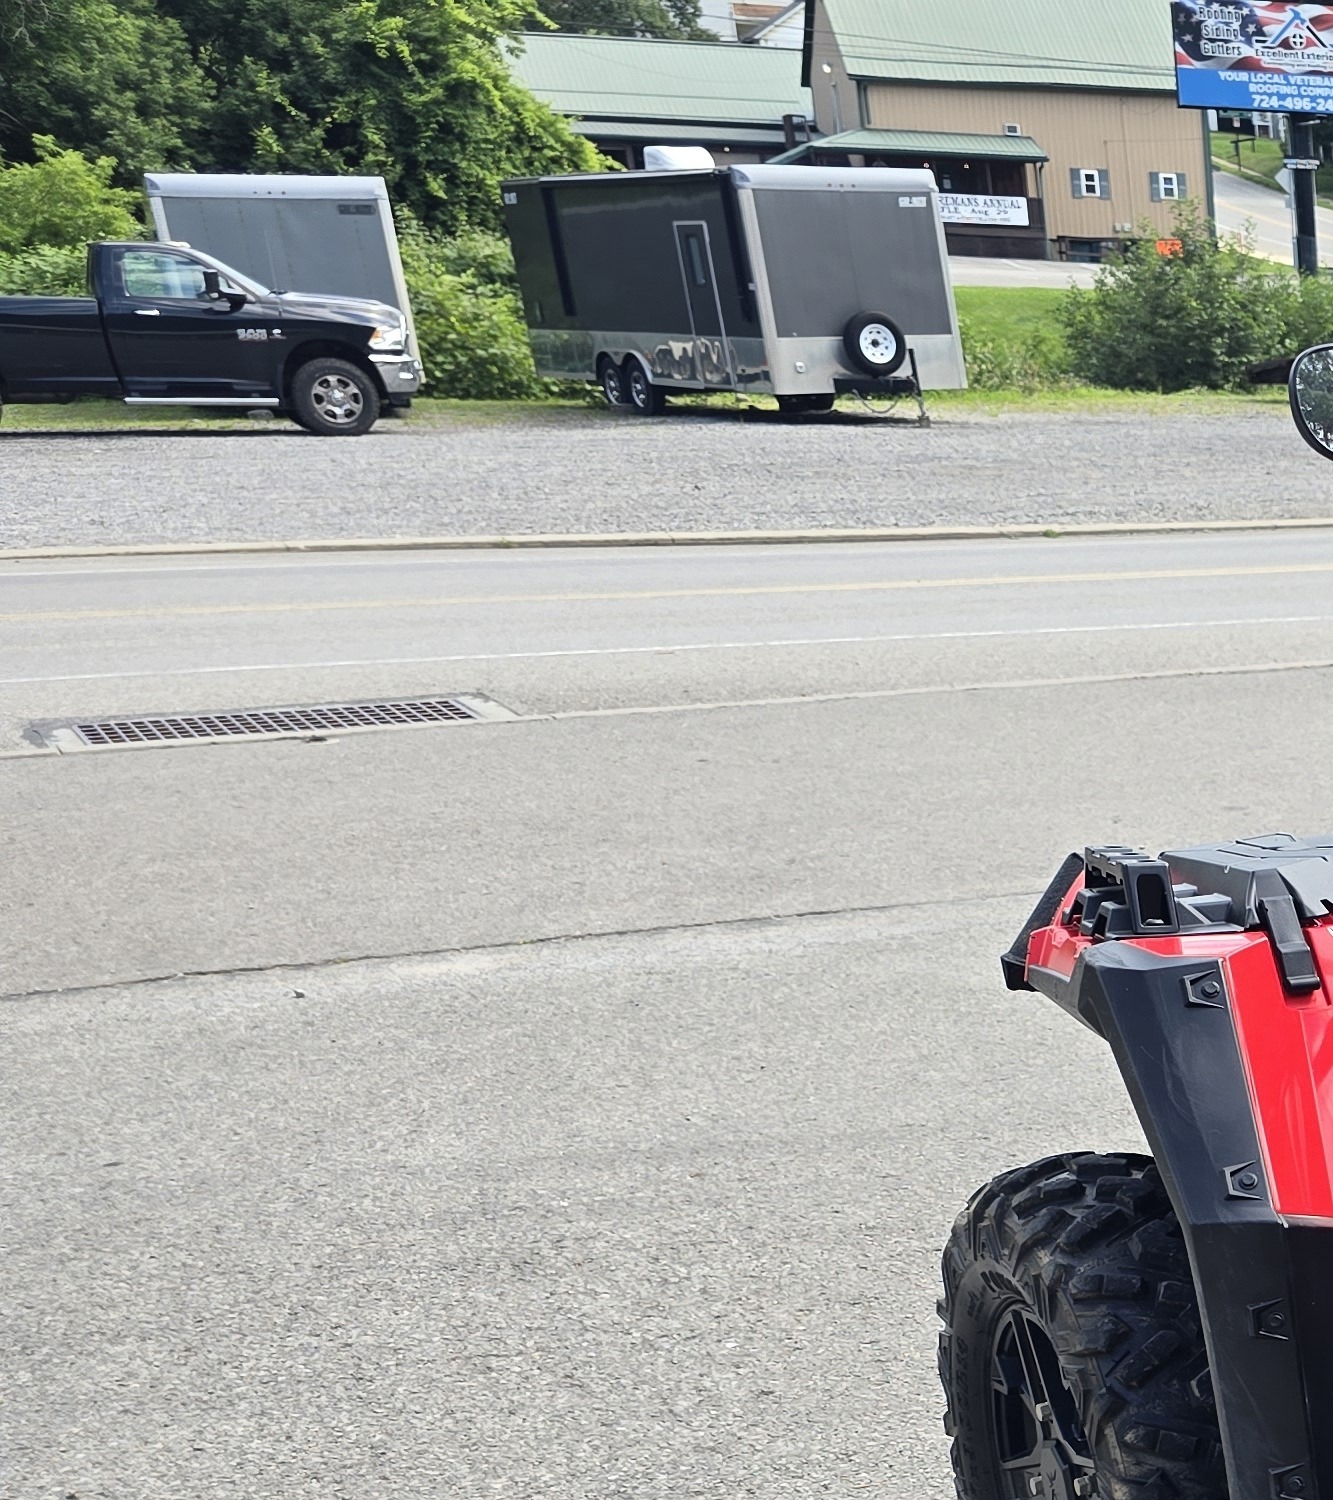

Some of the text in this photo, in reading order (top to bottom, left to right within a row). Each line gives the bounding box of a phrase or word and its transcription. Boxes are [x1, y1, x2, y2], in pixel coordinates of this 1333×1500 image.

[1198, 6, 1241, 23] Roofing
[1203, 24, 1239, 40] Siding
[1203, 42, 1242, 56] Gutters
[1255, 48, 1299, 60] Excellent
[1218, 71, 1249, 83] YOUR
[1250, 72, 1287, 85] LOCAL
[1248, 83, 1298, 95] ROOFING
